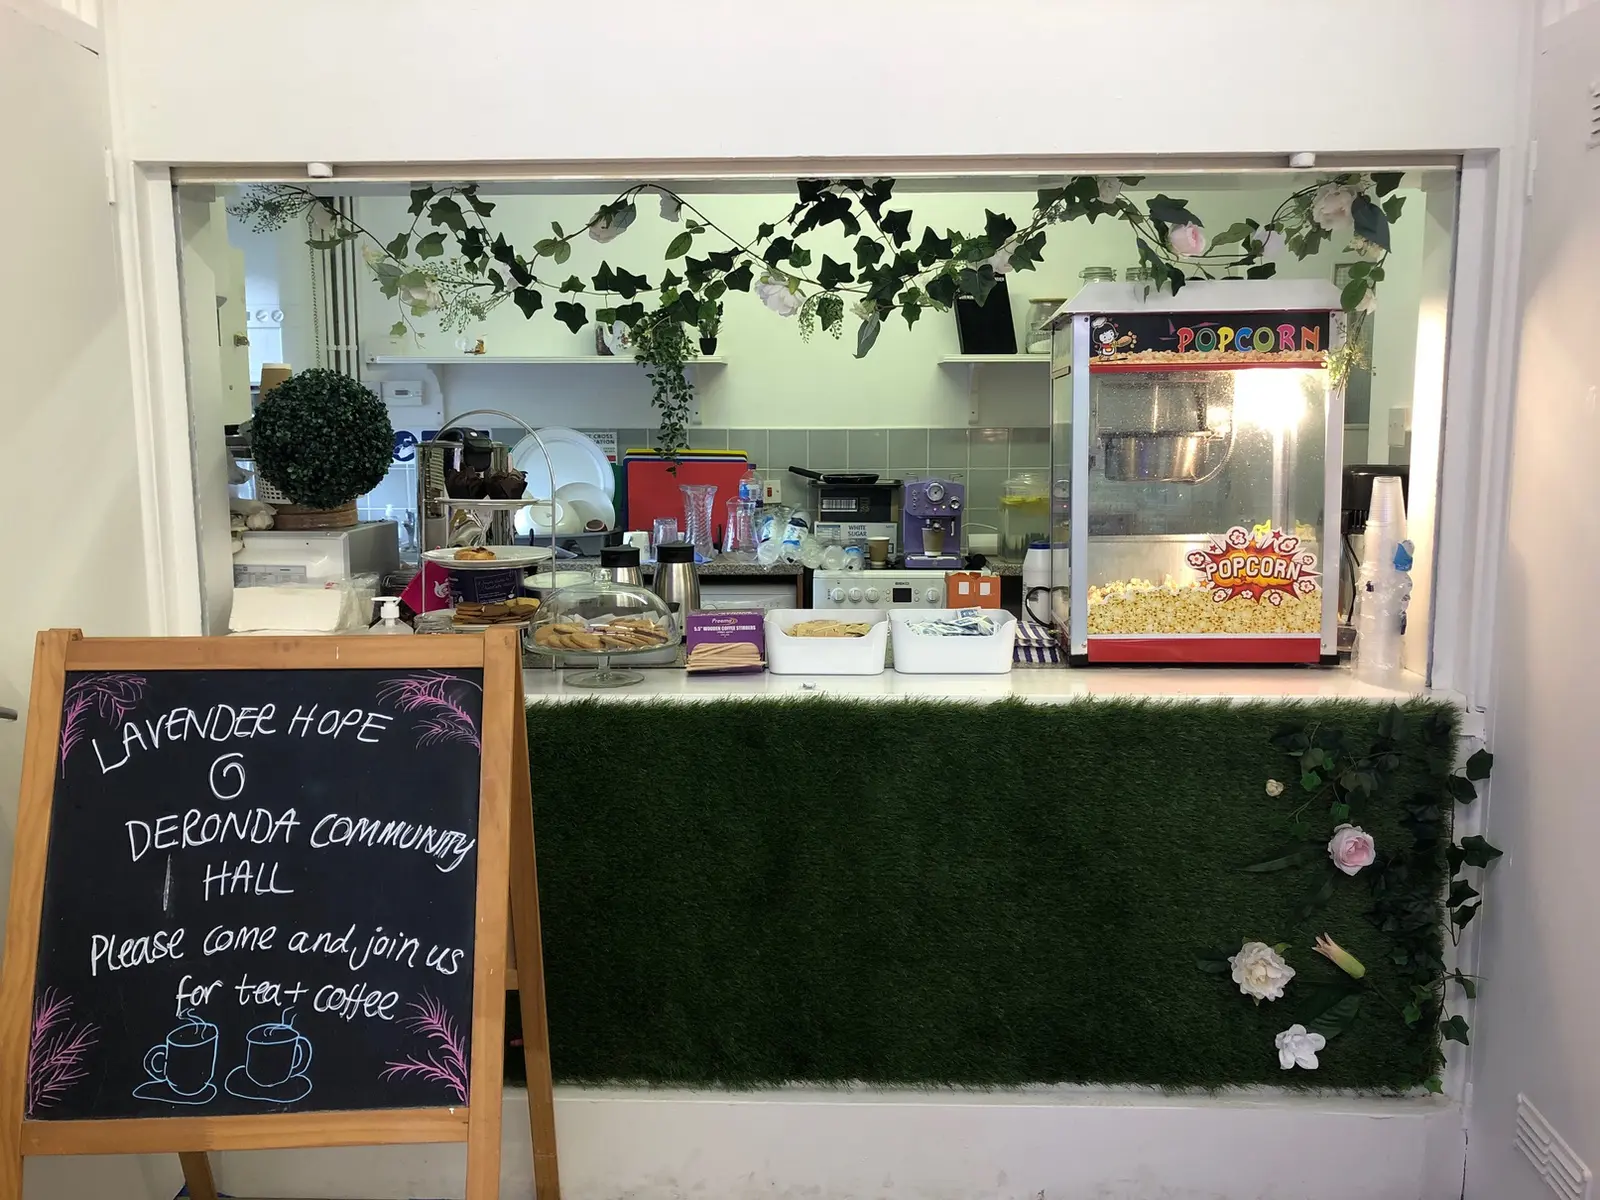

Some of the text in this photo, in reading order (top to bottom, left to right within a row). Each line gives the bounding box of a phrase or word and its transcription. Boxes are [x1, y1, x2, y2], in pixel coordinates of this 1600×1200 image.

[1176, 323, 1320, 353] POPCORN
[1205, 555, 1301, 581] POPCORN
[92, 702, 394, 774] LAVENDER HOPE
[125, 807, 476, 873] DERONDA COMMUNITY
[203, 860, 294, 901] HALL
[91, 923, 465, 976] Please come and join us
[175, 974, 223, 1017] for
[312, 982, 400, 1021] coffee
